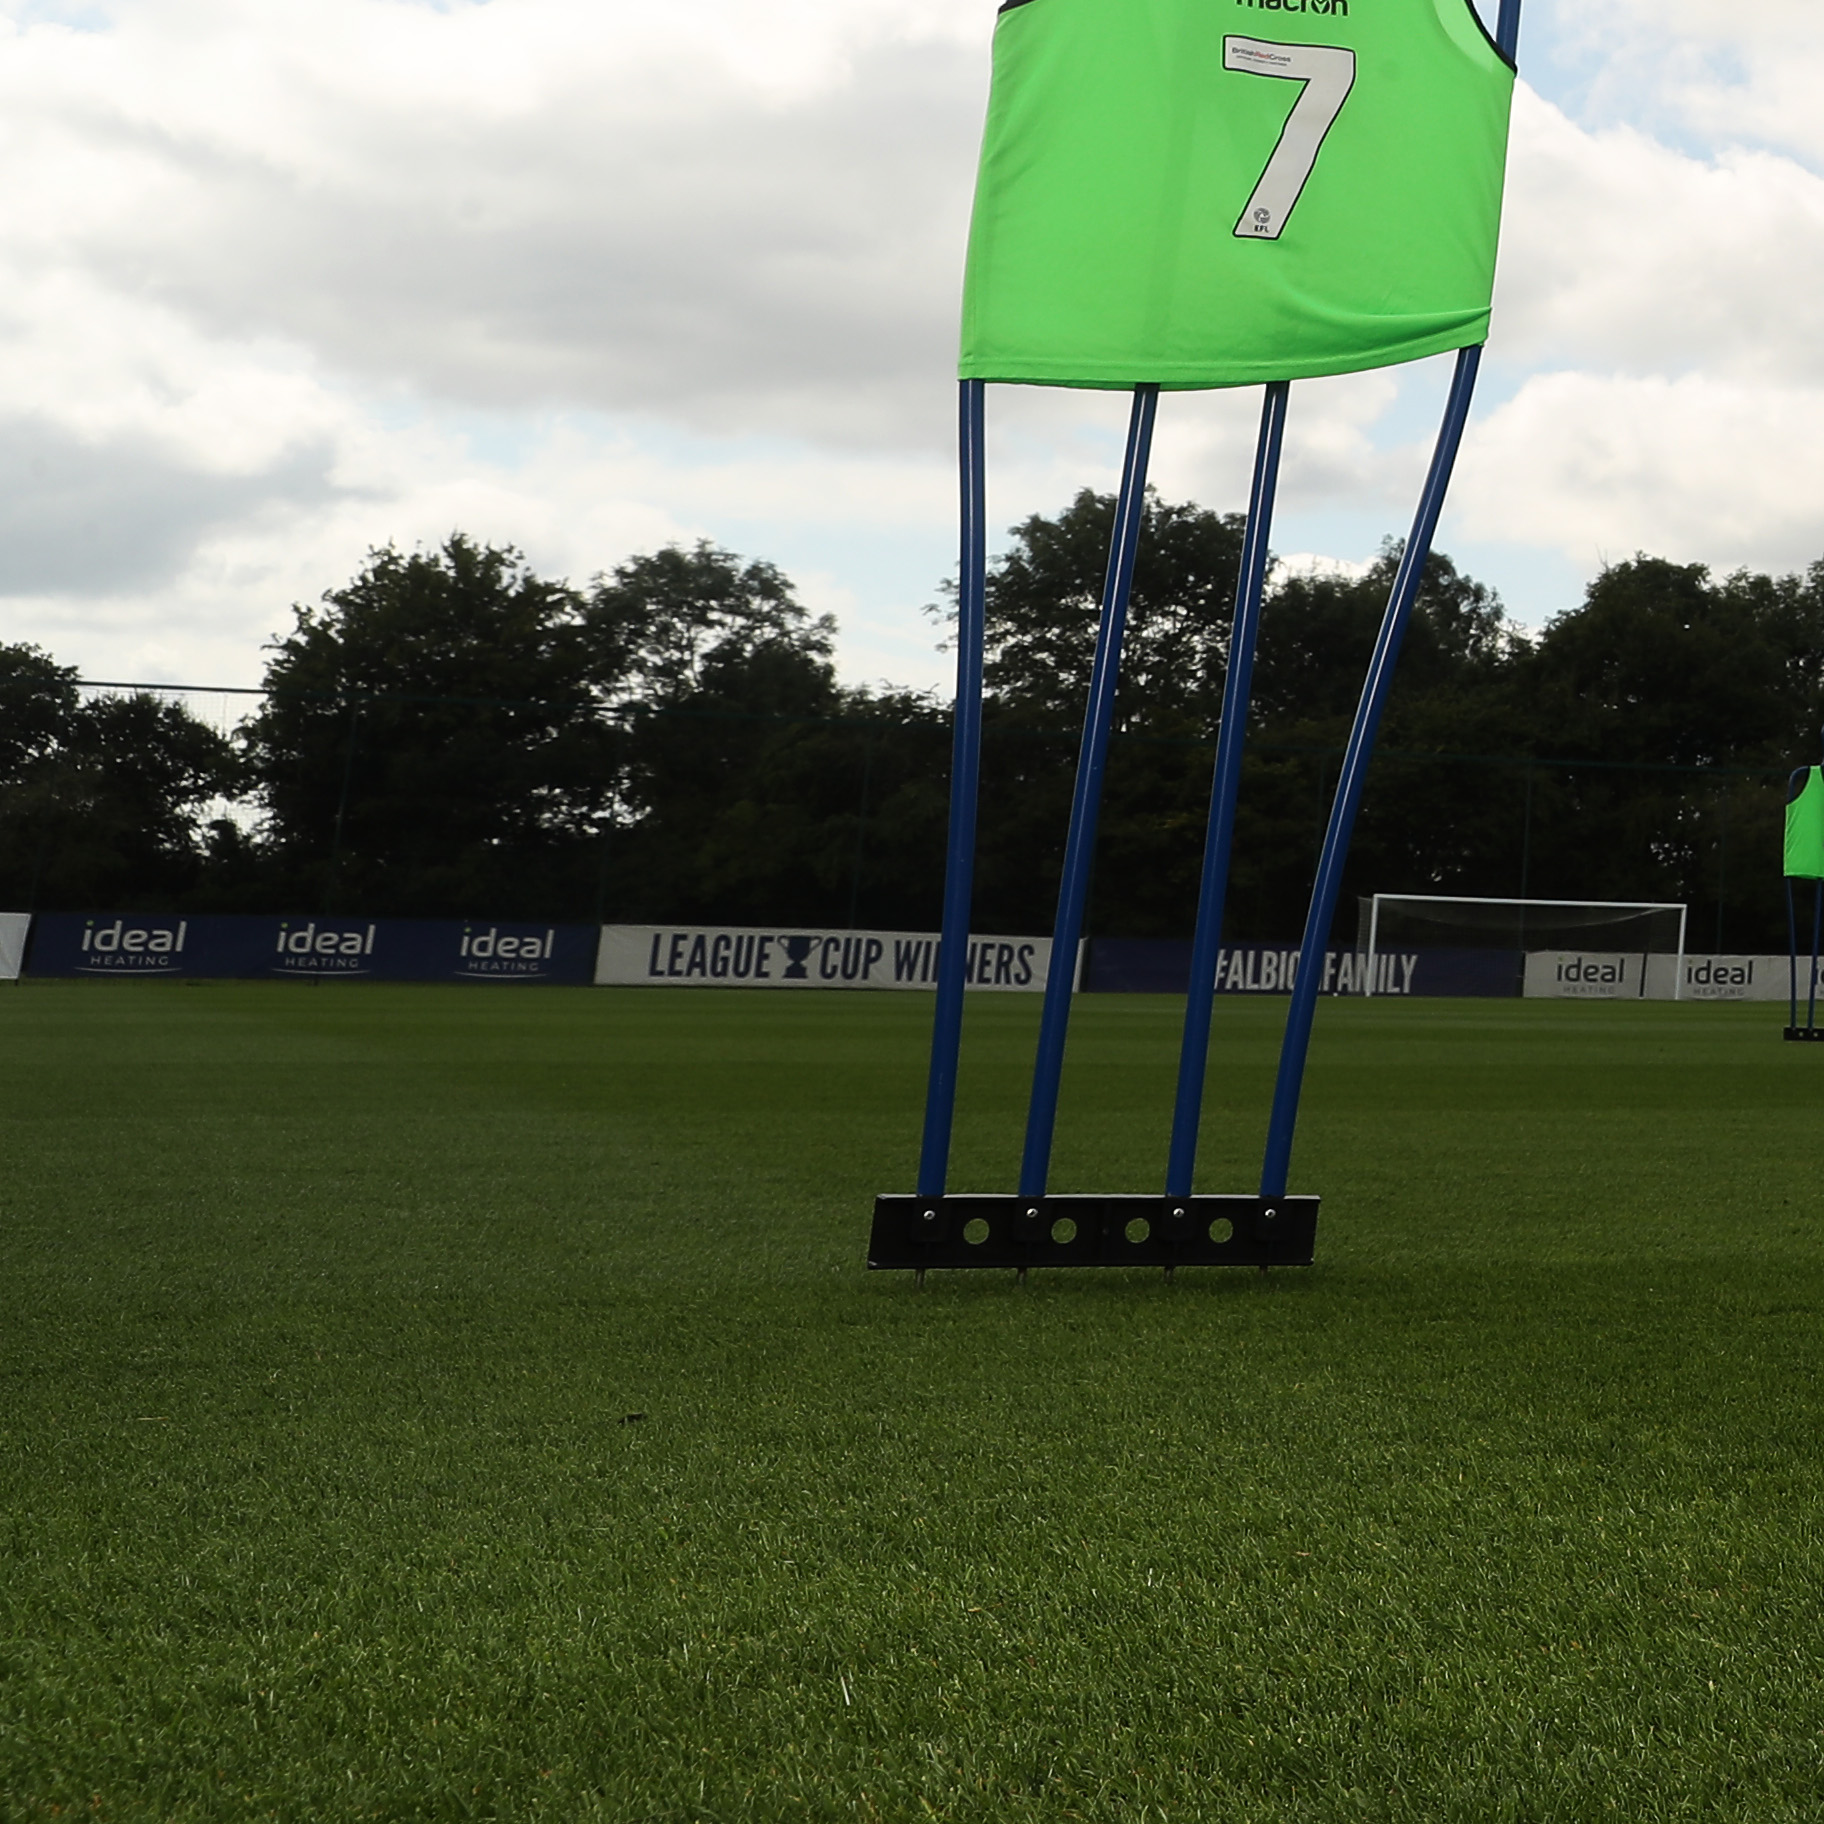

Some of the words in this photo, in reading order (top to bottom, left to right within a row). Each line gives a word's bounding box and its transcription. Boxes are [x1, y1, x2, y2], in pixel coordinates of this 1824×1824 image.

[1223, 35, 1356, 239] 7
[81, 919, 187, 952] ideal
[276, 922, 376, 955] ideal
[460, 927, 554, 959] ideal
[90, 955, 169, 967] HEATING
[285, 957, 359, 969] HEATING
[468, 960, 539, 972] HEATING
[649, 933, 775, 978] LEAGUE
[818, 936, 884, 981] CUP
[1213, 948, 1418, 994] #ALBIOFAMILY
[1556, 956, 1625, 983] ideal
[1687, 959, 1753, 986] ideal
